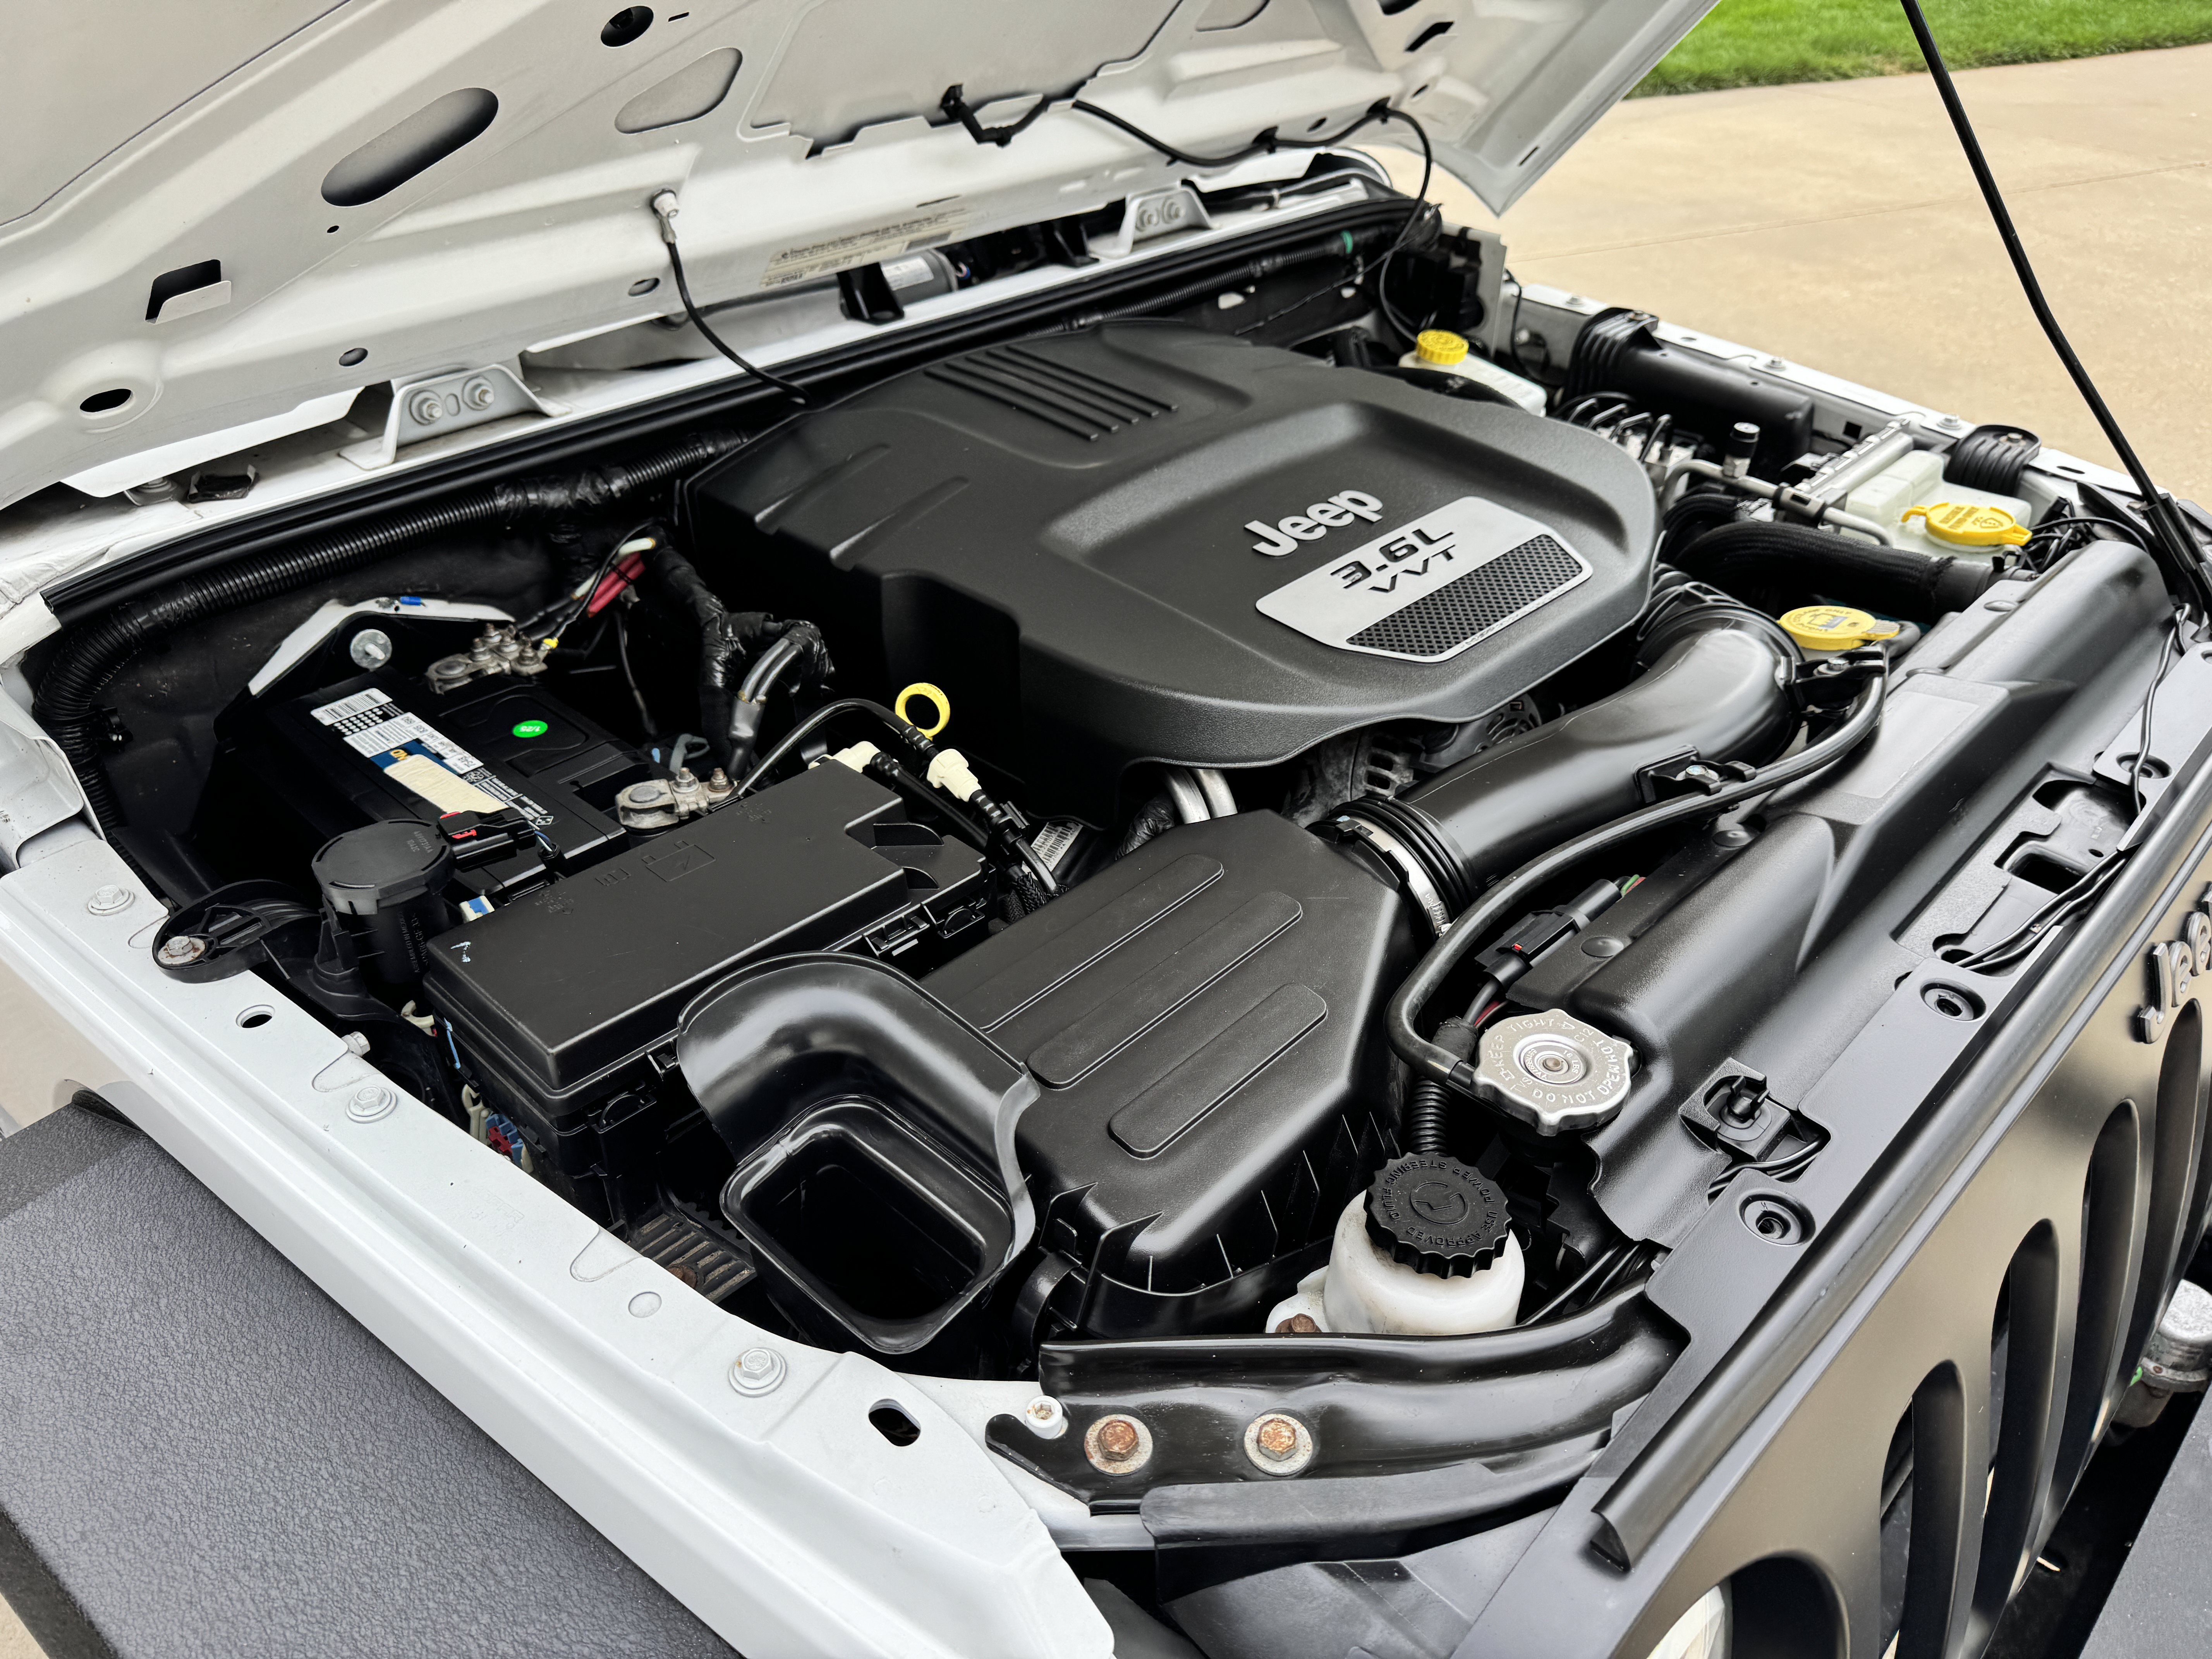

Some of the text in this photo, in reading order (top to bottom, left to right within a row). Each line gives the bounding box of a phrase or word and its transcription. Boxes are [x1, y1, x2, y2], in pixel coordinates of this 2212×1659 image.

[1244, 489, 1383, 556] Jeep
[1330, 528, 1455, 589] 3.6L
[1369, 544, 1455, 593] VVT
[2138, 881, 2212, 1044] Jee
[1491, 1019, 1554, 1068] KEEP TIGHT
[1575, 1028, 1594, 1042] C12
[1532, 1040, 1620, 1104] DO NOT OPEN HOT
[1571, 1060, 1580, 1074] LBS
[1382, 1160, 1498, 1248] USE APPROVED POWER STEERING FLUID
